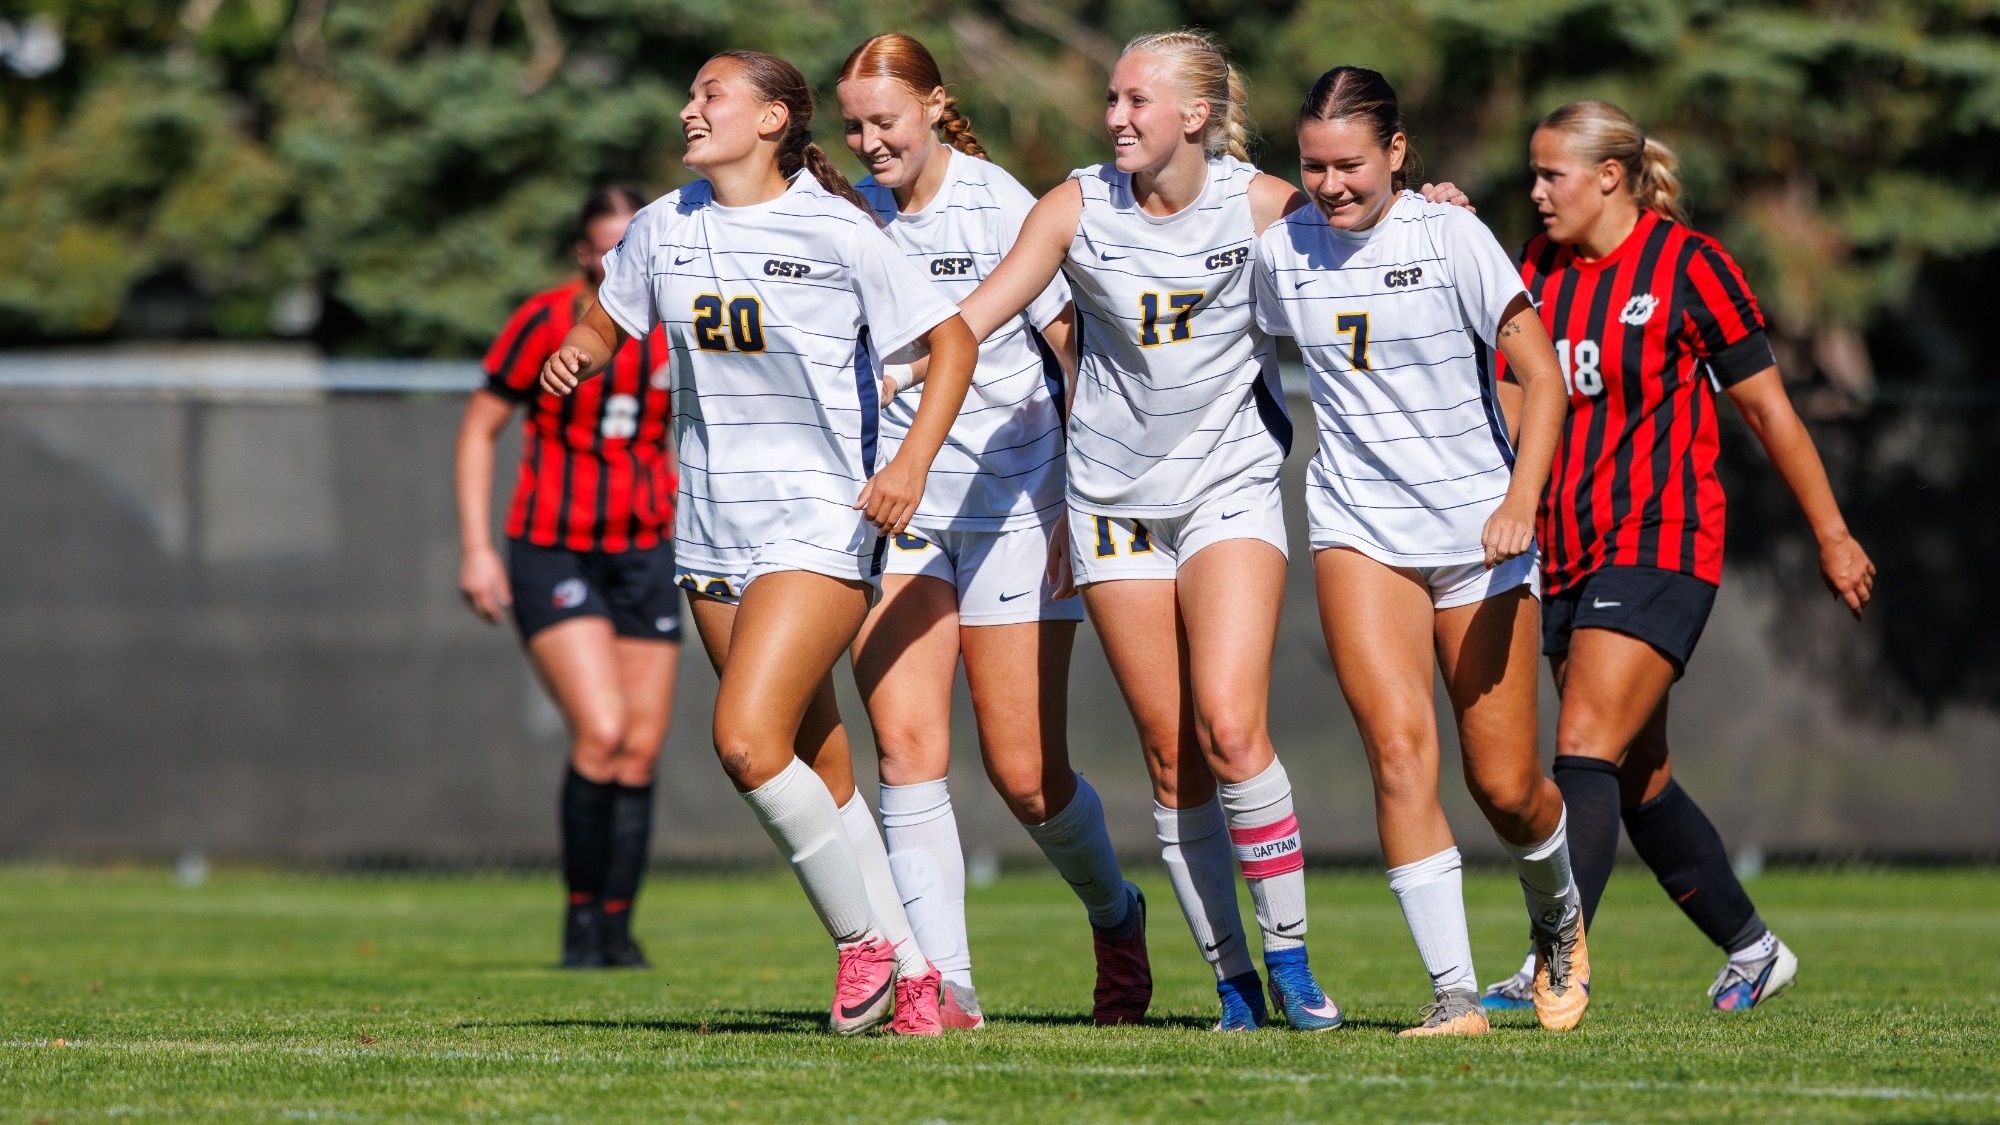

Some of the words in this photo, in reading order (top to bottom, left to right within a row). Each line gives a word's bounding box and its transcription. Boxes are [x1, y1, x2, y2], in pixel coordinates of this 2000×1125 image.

[763, 260, 811, 278] CSP
[931, 258, 973, 275] CSP
[1205, 246, 1249, 271] CSP
[1384, 266, 1423, 288] CSP
[692, 293, 765, 354] 20
[1139, 291, 1206, 348] 17
[1336, 312, 1371, 372] 7
[1556, 339, 1604, 396] 18
[1253, 837, 1296, 857] CAPTAIN
